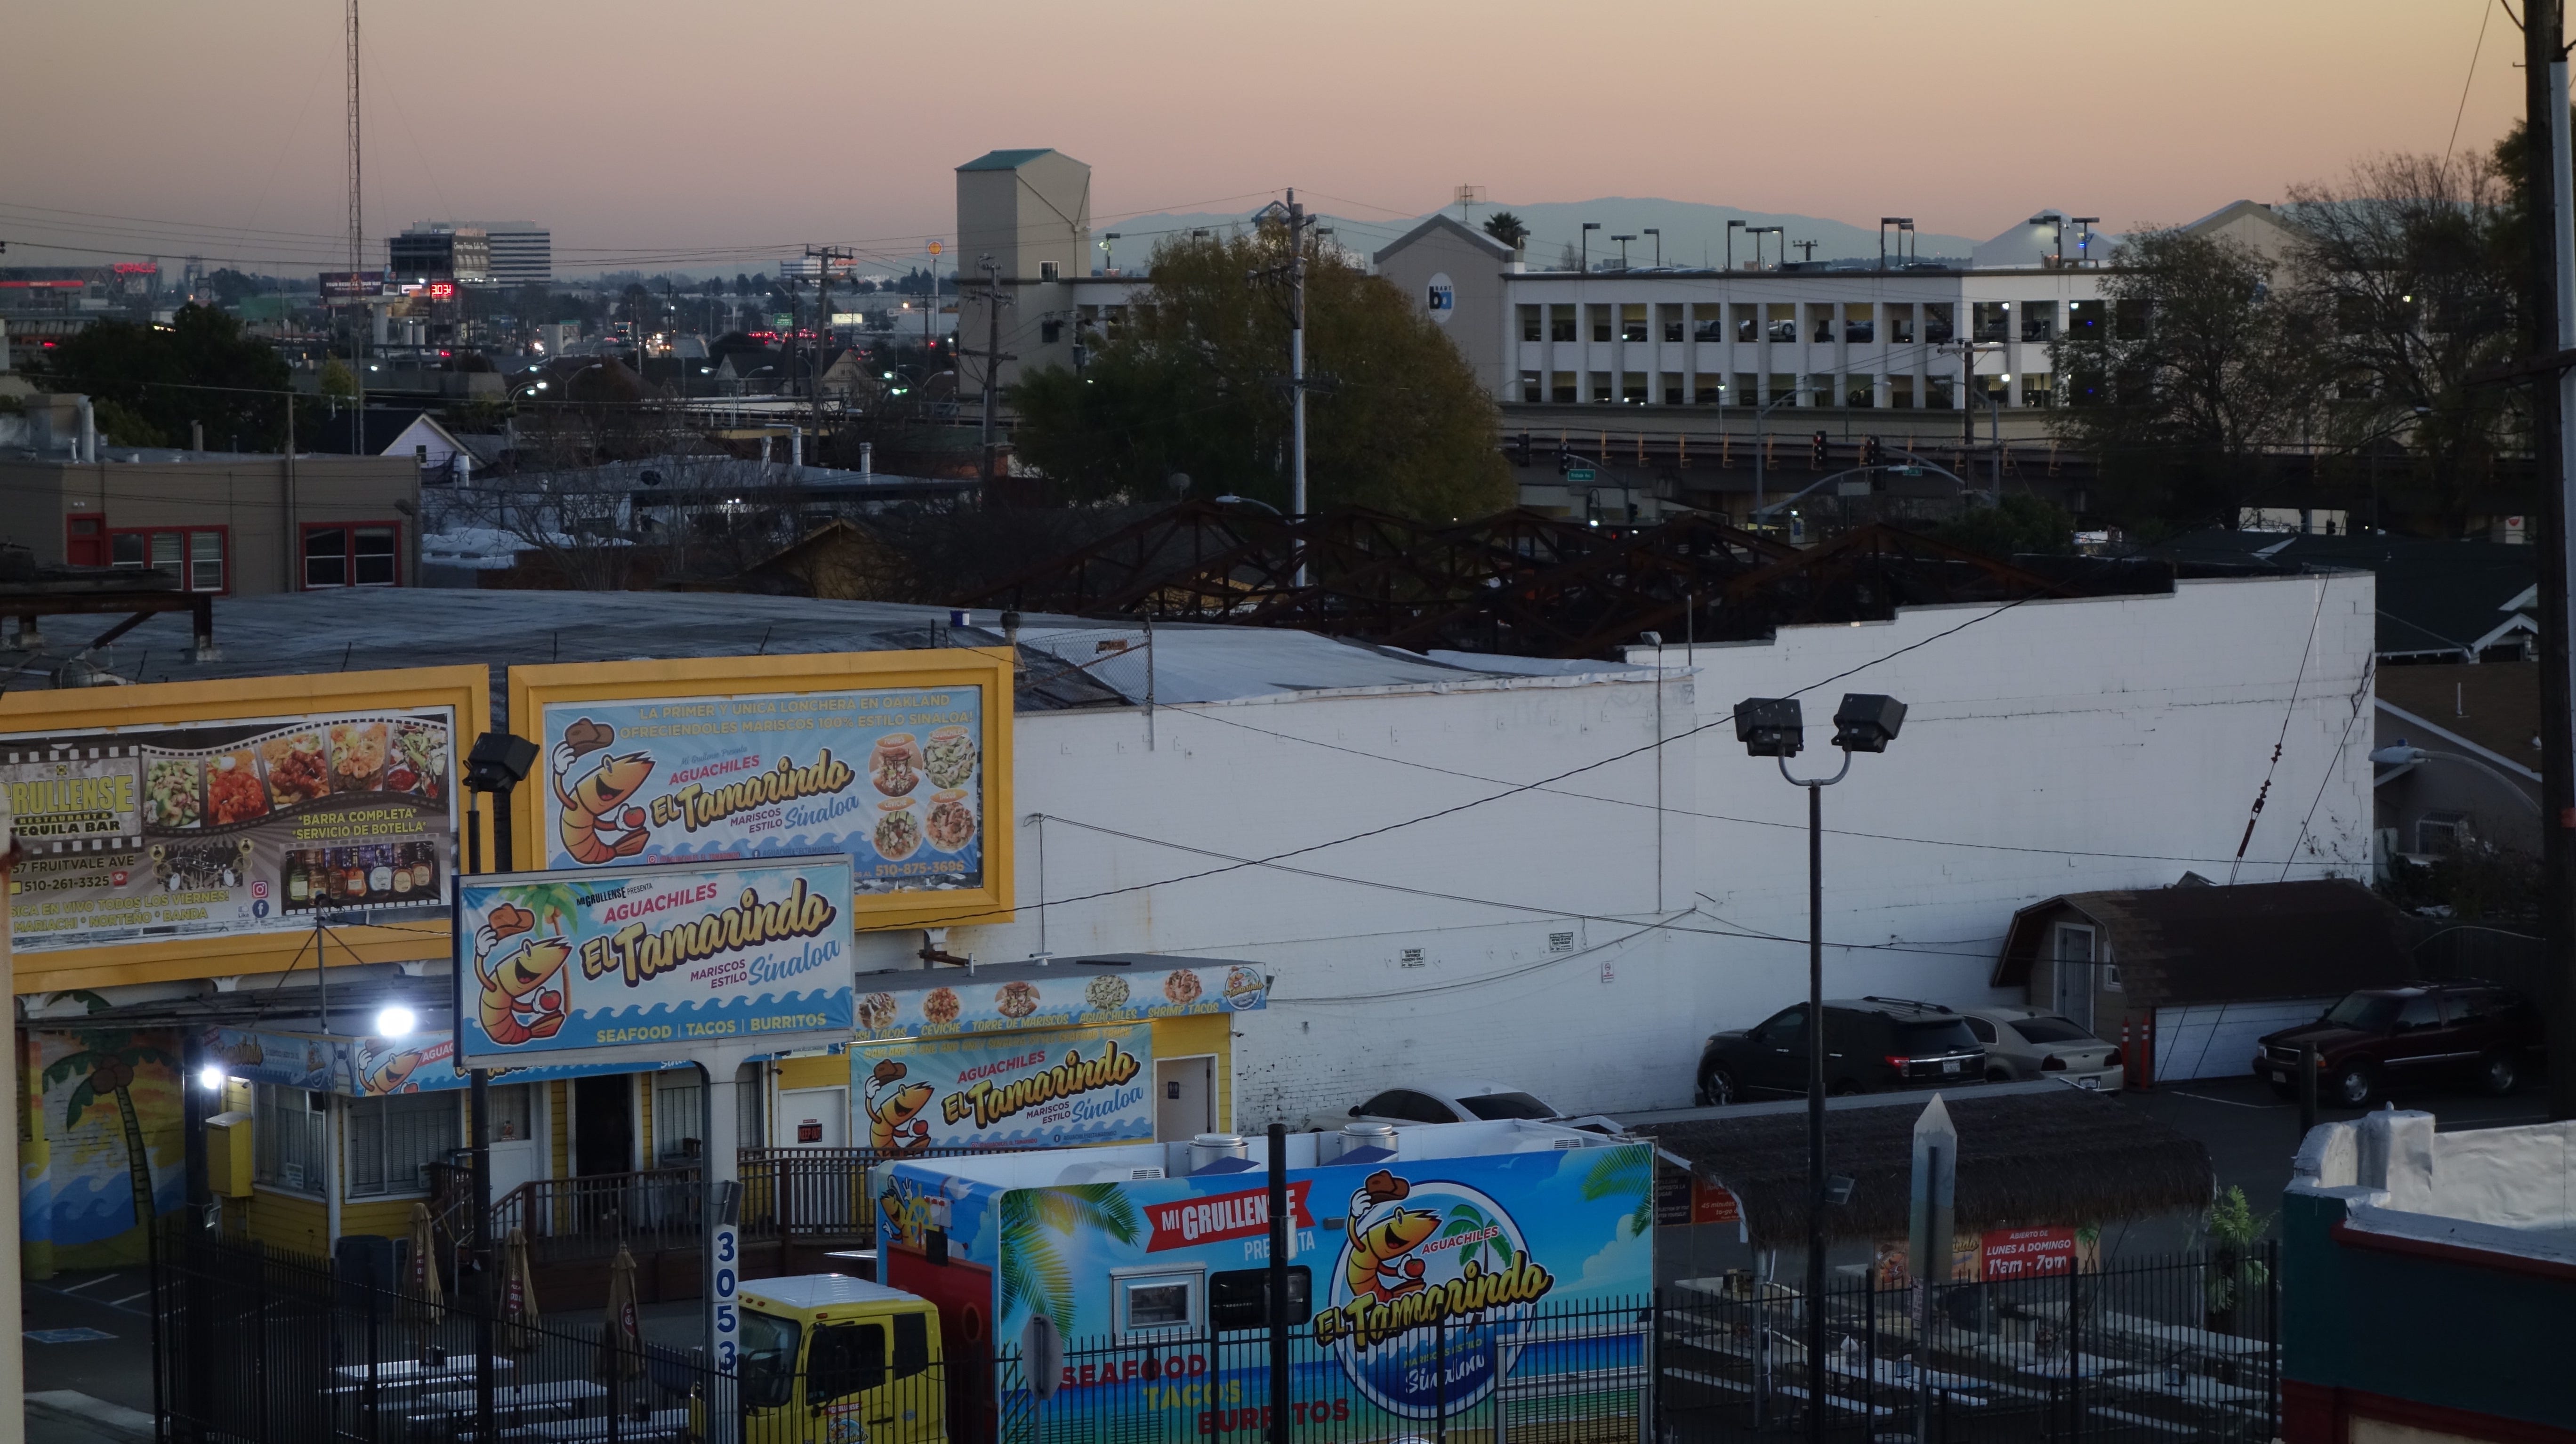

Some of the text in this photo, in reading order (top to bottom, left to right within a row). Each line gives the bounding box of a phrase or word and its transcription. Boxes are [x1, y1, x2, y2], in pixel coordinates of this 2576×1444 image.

[114, 262, 156, 274] ORACLE
[640, 695, 950, 719] LA PRIMER Y UNICA LONCHERA EN OAKLAND
[620, 711, 974, 739] OFRECIENDOLES MARISCOS 100% ESTILO SINALOA!
[669, 755, 760, 785] AGUACHILES
[651, 749, 854, 831] EL Tamarindo
[19, 814, 98, 824] RESTAURANT
[731, 808, 781, 826] MARISCOS
[784, 796, 859, 829] Sinaloa
[10, 821, 121, 836] TEQUILA BAR
[354, 825, 369, 836] DE
[749, 819, 782, 833] ESTILO
[32, 857, 104, 872] FRUITVALE
[109, 855, 135, 867] AVE
[875, 860, 965, 877] 510-875-3696
[25, 876, 110, 892] 510-261-3325
[577, 883, 653, 907] MI GRULLENSE PRESENTA
[11, 889, 230, 917] SICA EN VIVO TODOS LOS VIERNES!
[604, 882, 717, 924] AGUACHILES
[14, 907, 208, 933] MARIACHI NORTEÑO BANDA
[581, 878, 837, 987] EL Tamarindo
[690, 959, 746, 982] MARISCOS
[748, 940, 840, 986] Sinaloa
[711, 971, 748, 989] ESTILO
[973, 1013, 1069, 1031] TORRE DE MARISCOS
[1079, 1008, 1137, 1023] AGUACHILES
[1148, 1002, 1219, 1018] SHRIMP TACOS
[597, 1013, 827, 1043] SEAFOOD TACOS BURRITOS
[854, 1027, 907, 1041] ISH TACOS
[921, 1022, 961, 1036] CEVICHE
[422, 1039, 453, 1063] AGUAC
[957, 1050, 1046, 1084] AGUACHILES
[942, 1041, 1141, 1129] EL Tamarindo
[1026, 1101, 1070, 1119] MARISCOS
[1071, 1086, 1143, 1123] Sinaloa
[1042, 1110, 1071, 1124] ESTILO
[1161, 1189, 1297, 1240] MI GRULLENE
[1244, 1230, 1316, 1261] PRETA
[1422, 1226, 1499, 1254] AGUACHILES
[2009, 1229, 2048, 1240] ABIERTO DE
[1987, 1244, 2017, 1256] LUNES
[2018, 1243, 2026, 1253] A
[2027, 1239, 2071, 1252] DOMINGO
[1989, 1258, 2022, 1275] 11am
[2036, 1254, 2067, 1272] 7pm
[716, 1232, 737, 1371] 3053
[1315, 1250, 1554, 1352] EL Tamarindo
[1404, 1347, 1450, 1369] MARISCS
[1061, 1354, 1207, 1390] SEAFOOD
[1143, 1379, 1243, 1411] TACOS
[1198, 1397, 1351, 1435] BURRTOS
